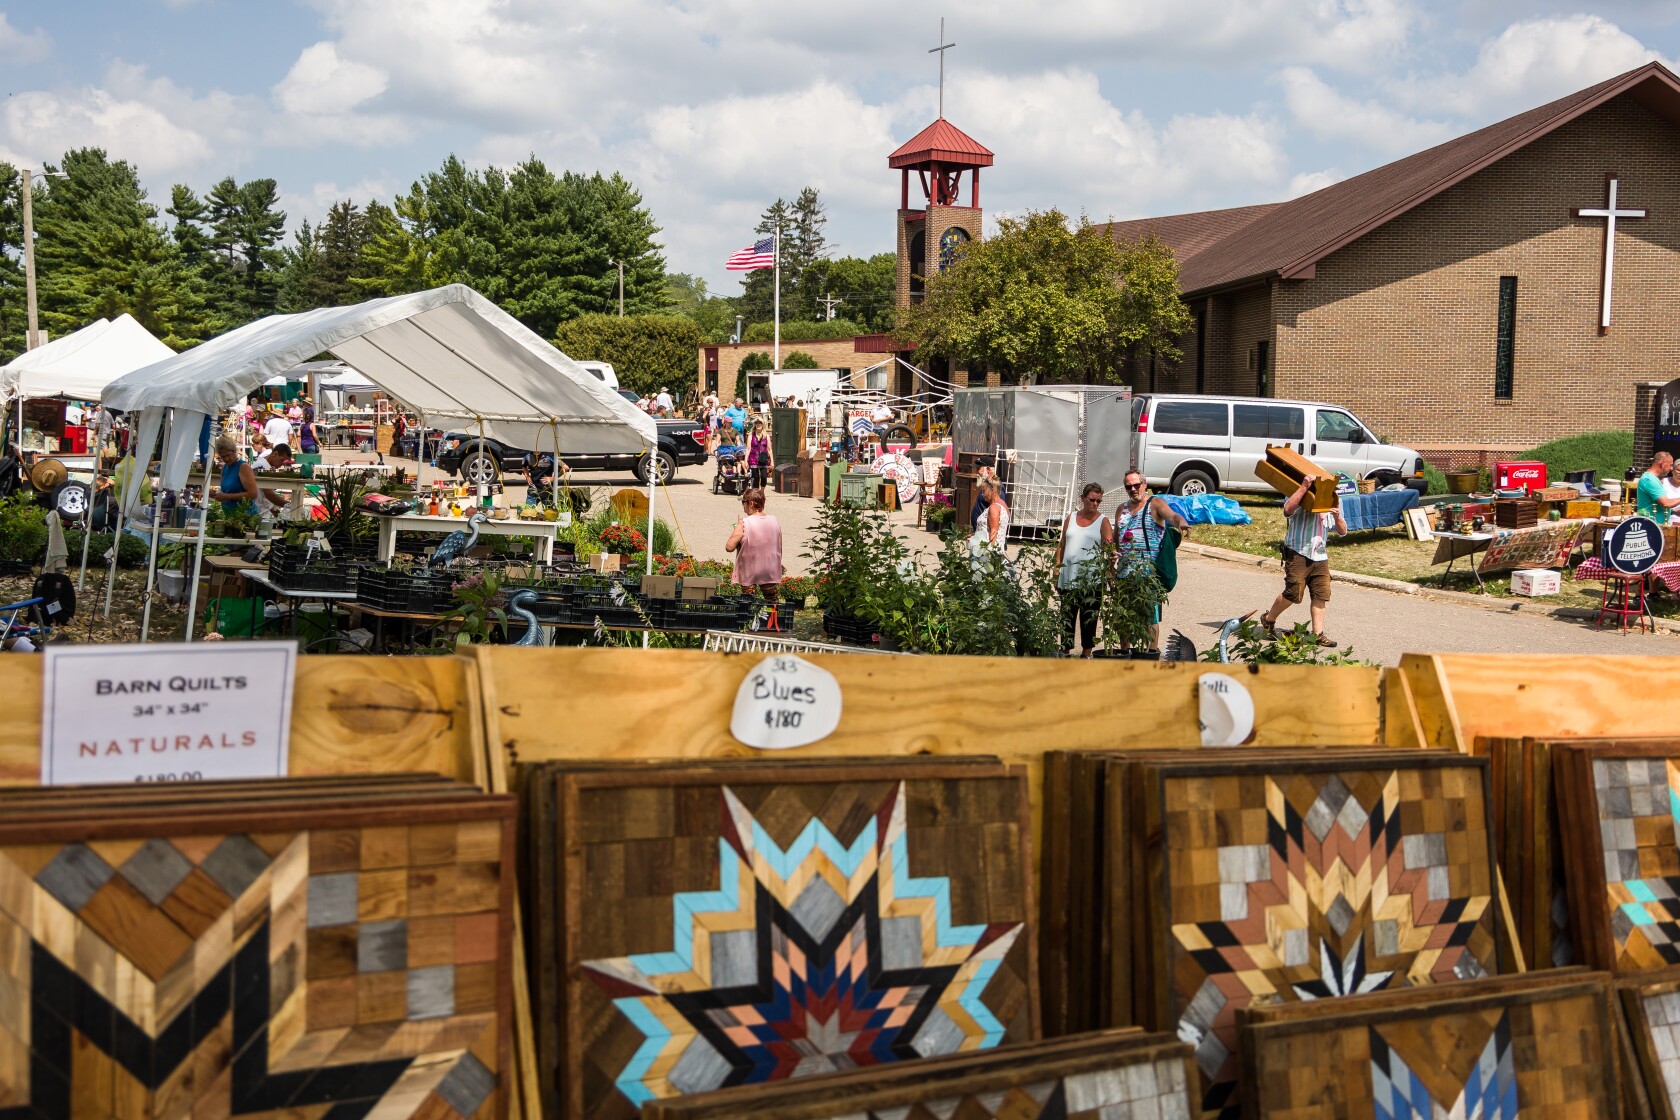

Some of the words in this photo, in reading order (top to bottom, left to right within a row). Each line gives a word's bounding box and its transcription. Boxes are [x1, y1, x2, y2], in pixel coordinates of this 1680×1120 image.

[1513, 470, 1539, 478] Coca-Cola
[1620, 551, 1653, 559] TELEPHONE
[96, 680, 161, 695] BARN
[169, 676, 247, 692] QUILTS
[751, 674, 816, 704] Blues
[765, 709, 803, 728] $180
[79, 731, 256, 757] NATURALS
